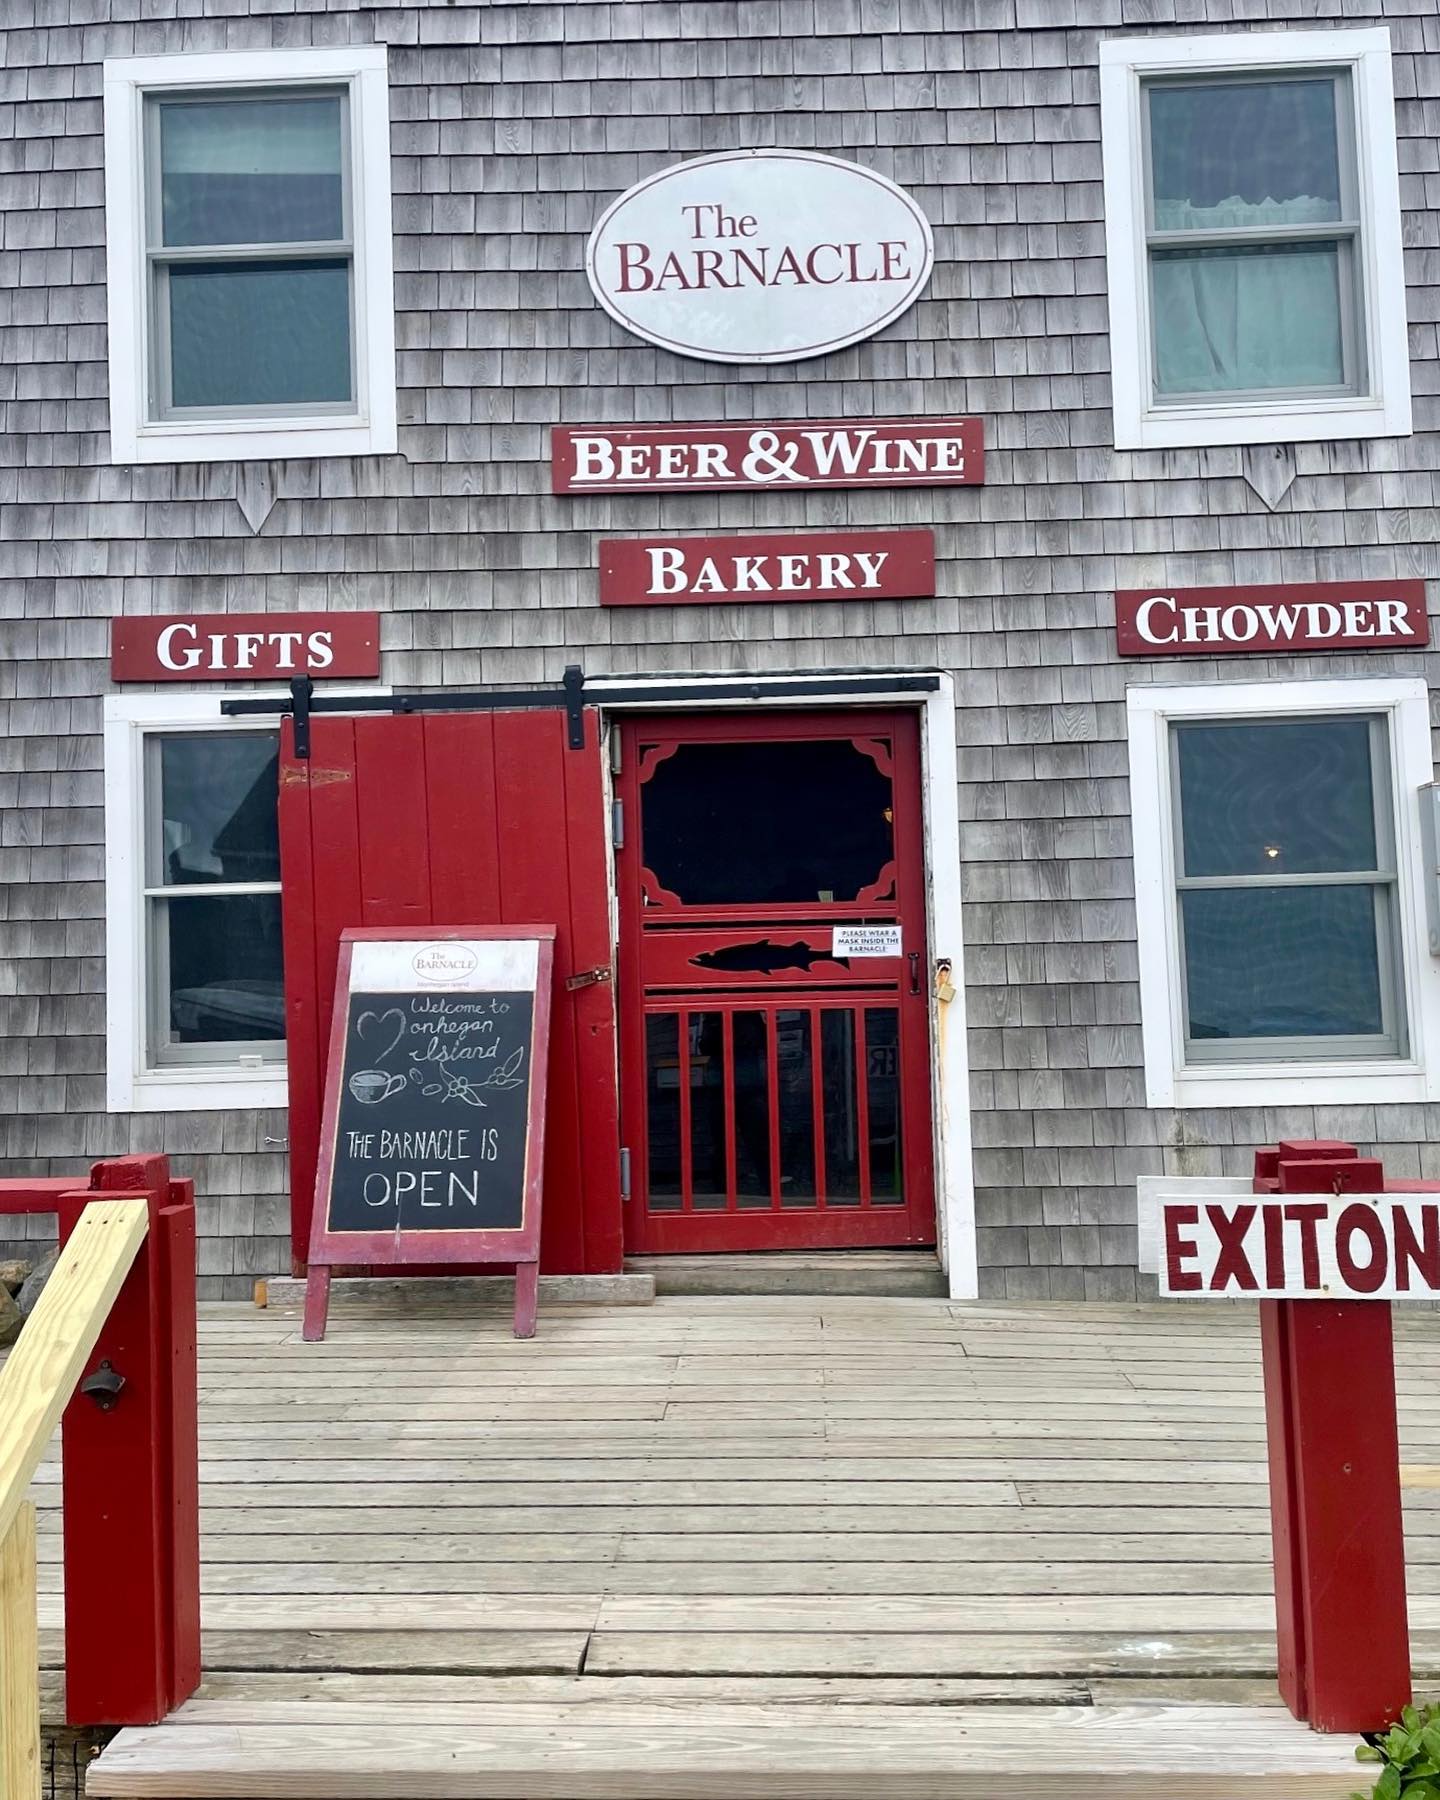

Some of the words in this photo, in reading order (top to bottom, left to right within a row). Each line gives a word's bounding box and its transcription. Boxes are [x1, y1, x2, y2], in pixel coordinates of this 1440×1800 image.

[682, 204, 759, 239] The
[613, 241, 912, 293] BARNACLE
[646, 546, 889, 594] BAKERY
[1135, 595, 1415, 645] CHOWDER
[157, 622, 334, 671] GIFTS
[416, 959, 474, 969] BARNACLE
[432, 952, 445, 960] The
[410, 997, 485, 1014] Welcome
[490, 998, 510, 1014] to
[346, 1131, 376, 1159] THE
[379, 1129, 471, 1160] BARNACLE
[480, 1128, 499, 1161] IS
[363, 1169, 479, 1207] OPEN
